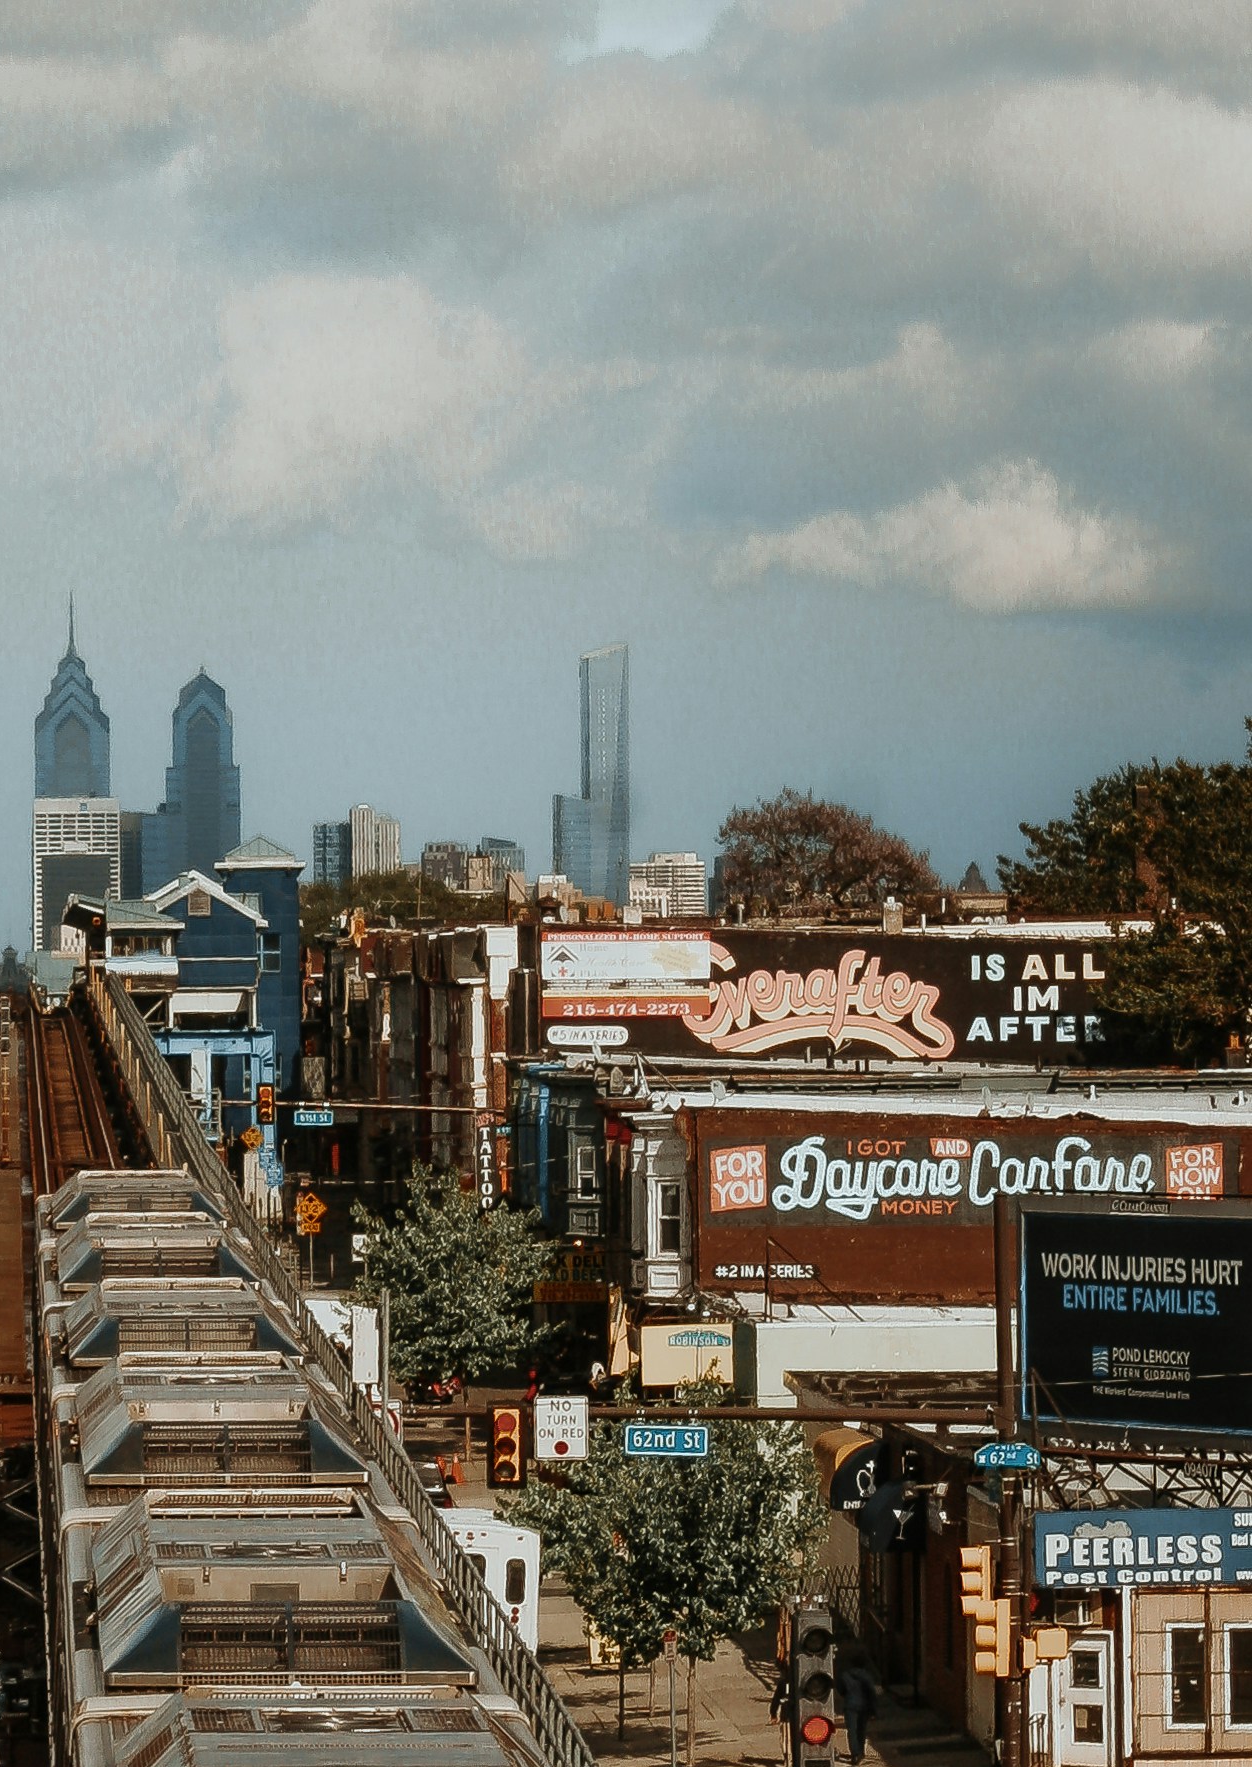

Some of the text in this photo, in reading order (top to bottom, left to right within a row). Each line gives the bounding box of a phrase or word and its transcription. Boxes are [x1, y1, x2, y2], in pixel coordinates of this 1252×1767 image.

[547, 932, 617, 941] PERSONALIZED
[661, 932, 704, 941] SUPPORT
[971, 953, 1107, 982] IS ALL
[1013, 985, 1059, 1012] IM
[563, 1002, 691, 1016] 215-474-2273
[967, 1015, 1107, 1043] AFTER
[857, 1140, 907, 1156] GOT
[934, 1140, 968, 1156] AND
[715, 1151, 764, 1182] FOR
[1169, 1146, 1215, 1169] FOR
[479, 1127, 493, 1209] TATTOO
[1169, 1166, 1220, 1188] NOW
[771, 1136, 962, 1220] Daycare
[713, 1177, 764, 1208] YOU
[880, 1199, 959, 1215] MONEY
[715, 1264, 738, 1278] #2
[1041, 1252, 1243, 1286] WORK INJURIES HURT
[1063, 1284, 1220, 1316] ENTIRE FAMILIES.
[1112, 1347, 1191, 1366] POND LEHOCKY
[1112, 1368, 1140, 1379] STERN
[550, 1401, 572, 1412] NO
[547, 1415, 577, 1425] TURN
[539, 1428, 584, 1439] ON RED
[633, 1431, 700, 1449] 62nd St
[989, 1451, 1039, 1465] 62nd St
[1045, 1534, 1223, 1567] PEERLESS
[1046, 1568, 1222, 1585] Pest Control
